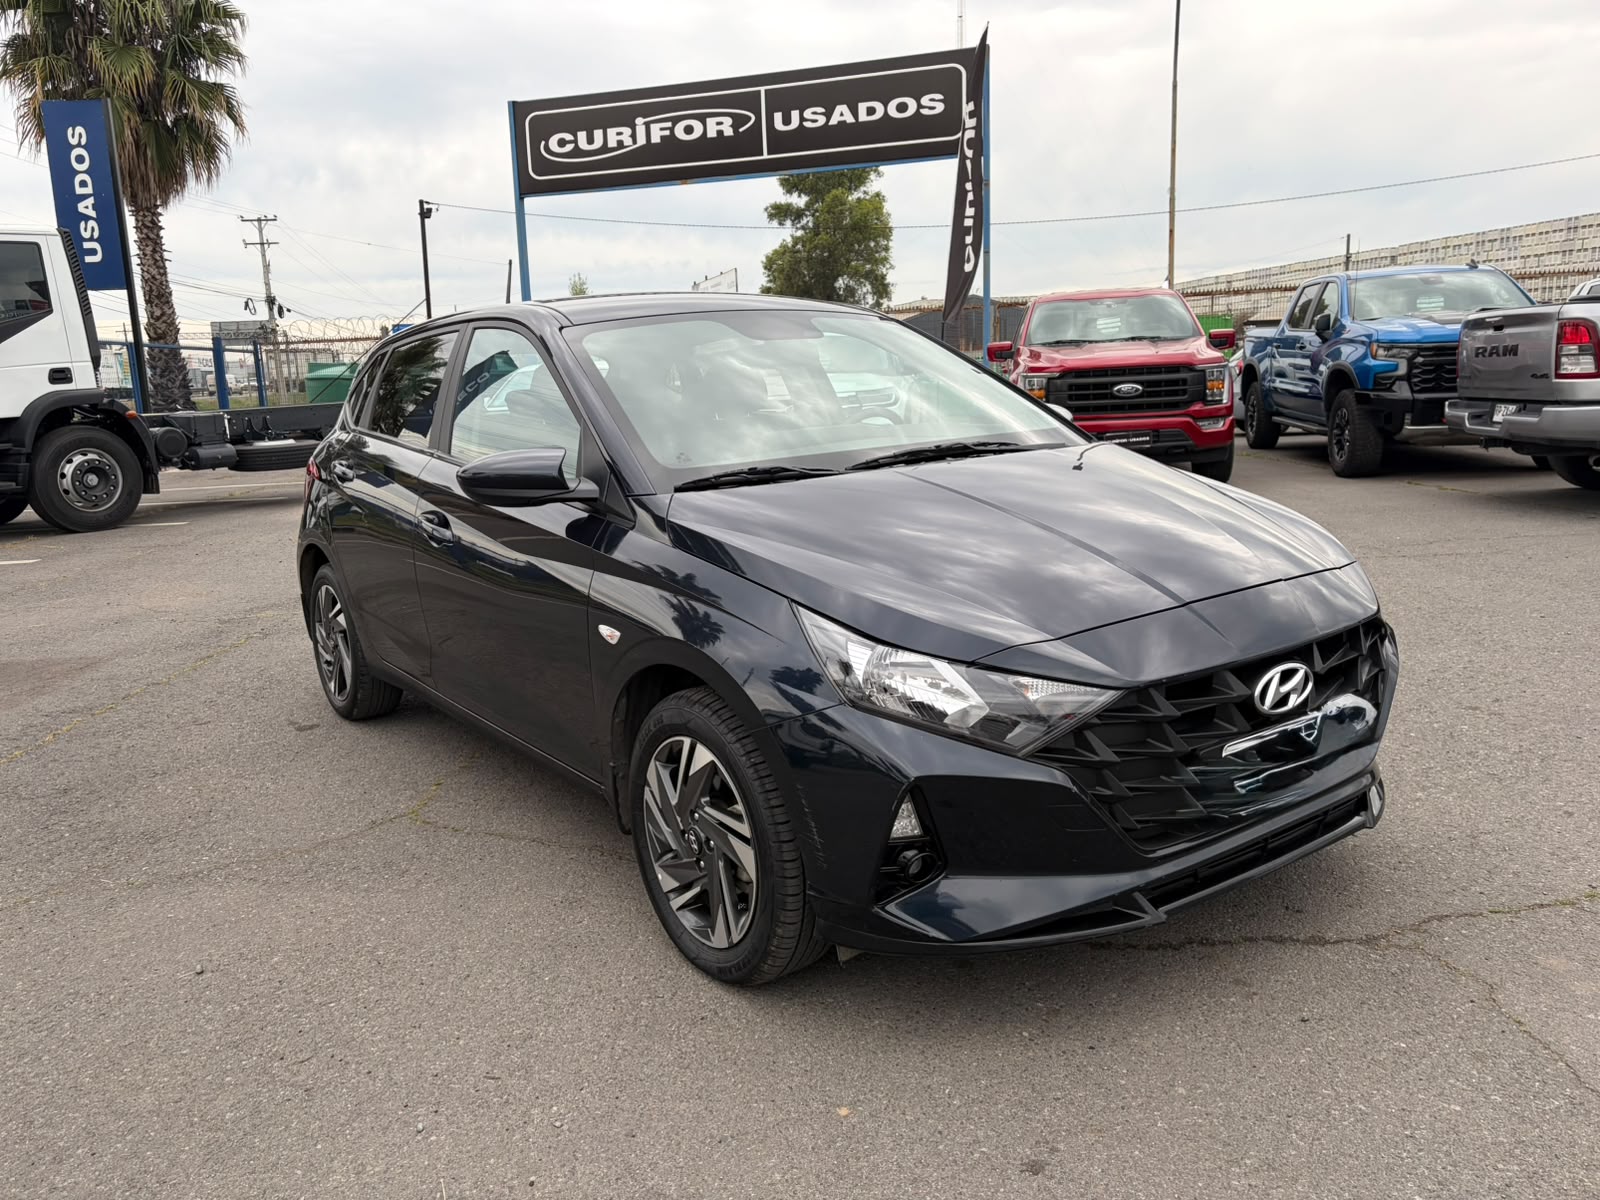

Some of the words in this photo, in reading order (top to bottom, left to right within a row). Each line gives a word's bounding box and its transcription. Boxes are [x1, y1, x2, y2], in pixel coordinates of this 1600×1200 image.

[773, 93, 945, 131] USADOS
[67, 125, 103, 263] USADOS
[1474, 344, 1519, 358] RAM
